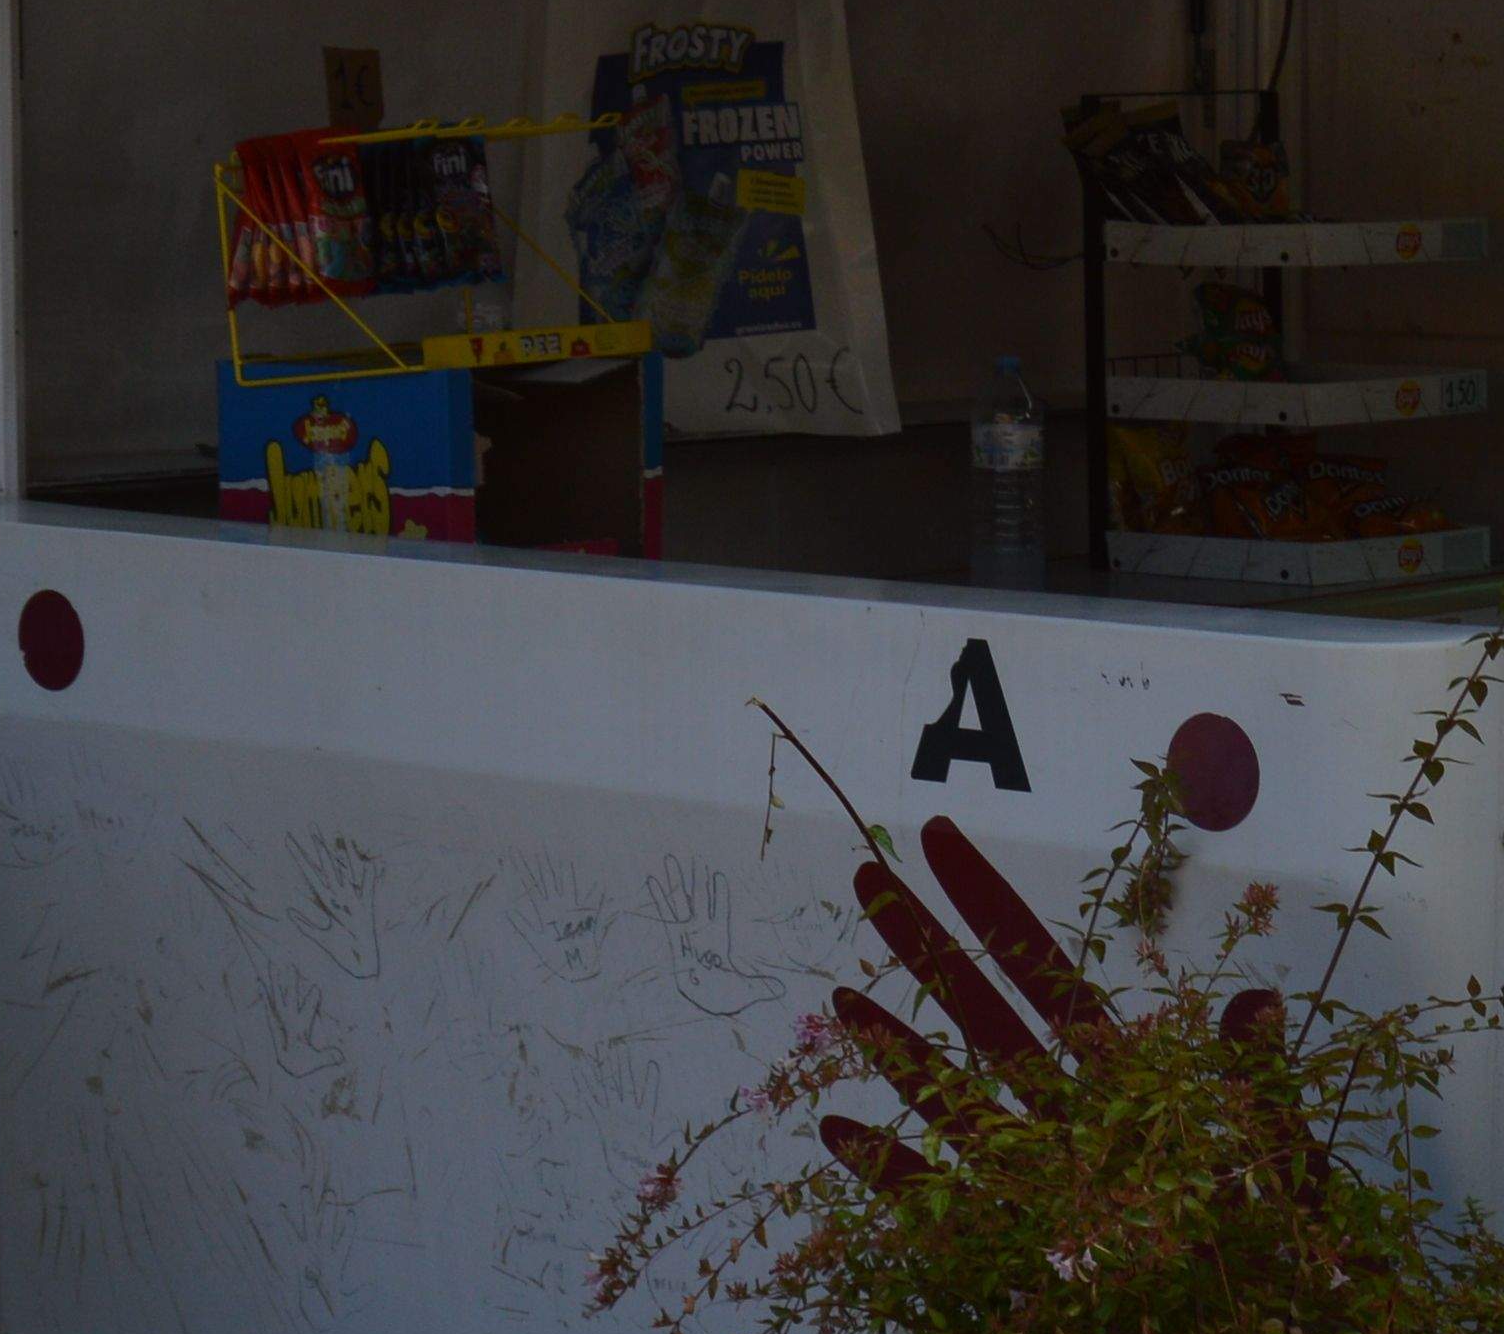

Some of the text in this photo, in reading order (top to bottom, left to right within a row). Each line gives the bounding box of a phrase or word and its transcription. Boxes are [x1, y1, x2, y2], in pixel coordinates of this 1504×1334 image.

[632, 22, 754, 74] FROSTY
[681, 104, 801, 147] FROZEN
[740, 141, 804, 163] POWER
[910, 637, 1032, 793] A
